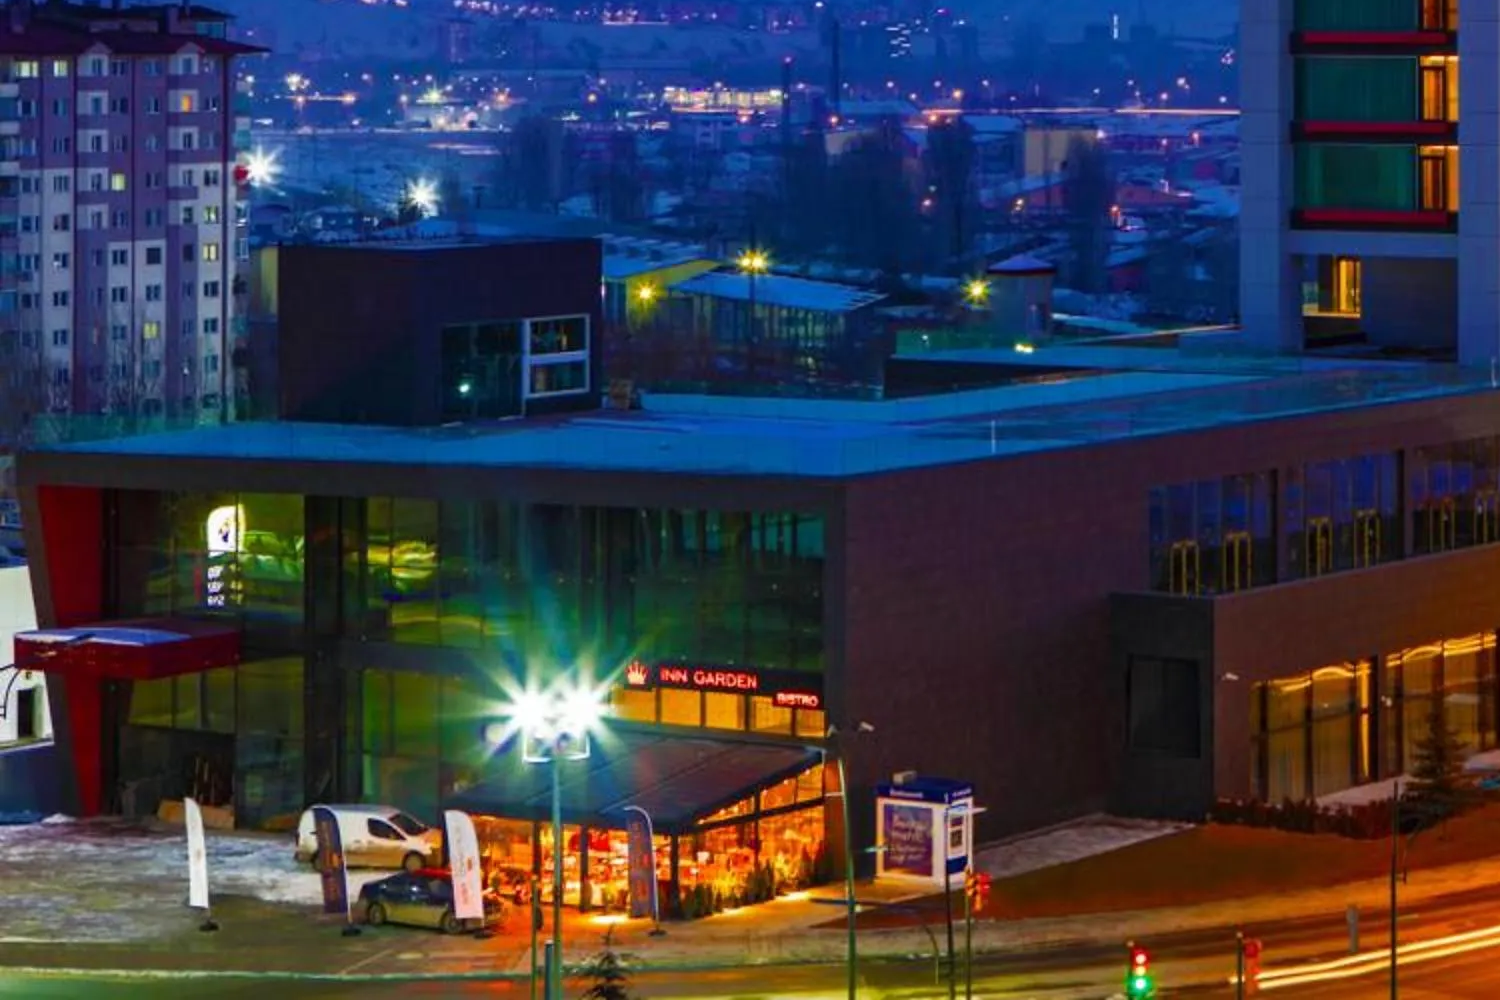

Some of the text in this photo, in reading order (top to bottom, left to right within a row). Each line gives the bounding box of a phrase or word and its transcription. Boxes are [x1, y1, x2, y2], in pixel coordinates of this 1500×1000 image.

[660, 667, 758, 689] INN GARDEN
[777, 693, 818, 707] BISTRO
